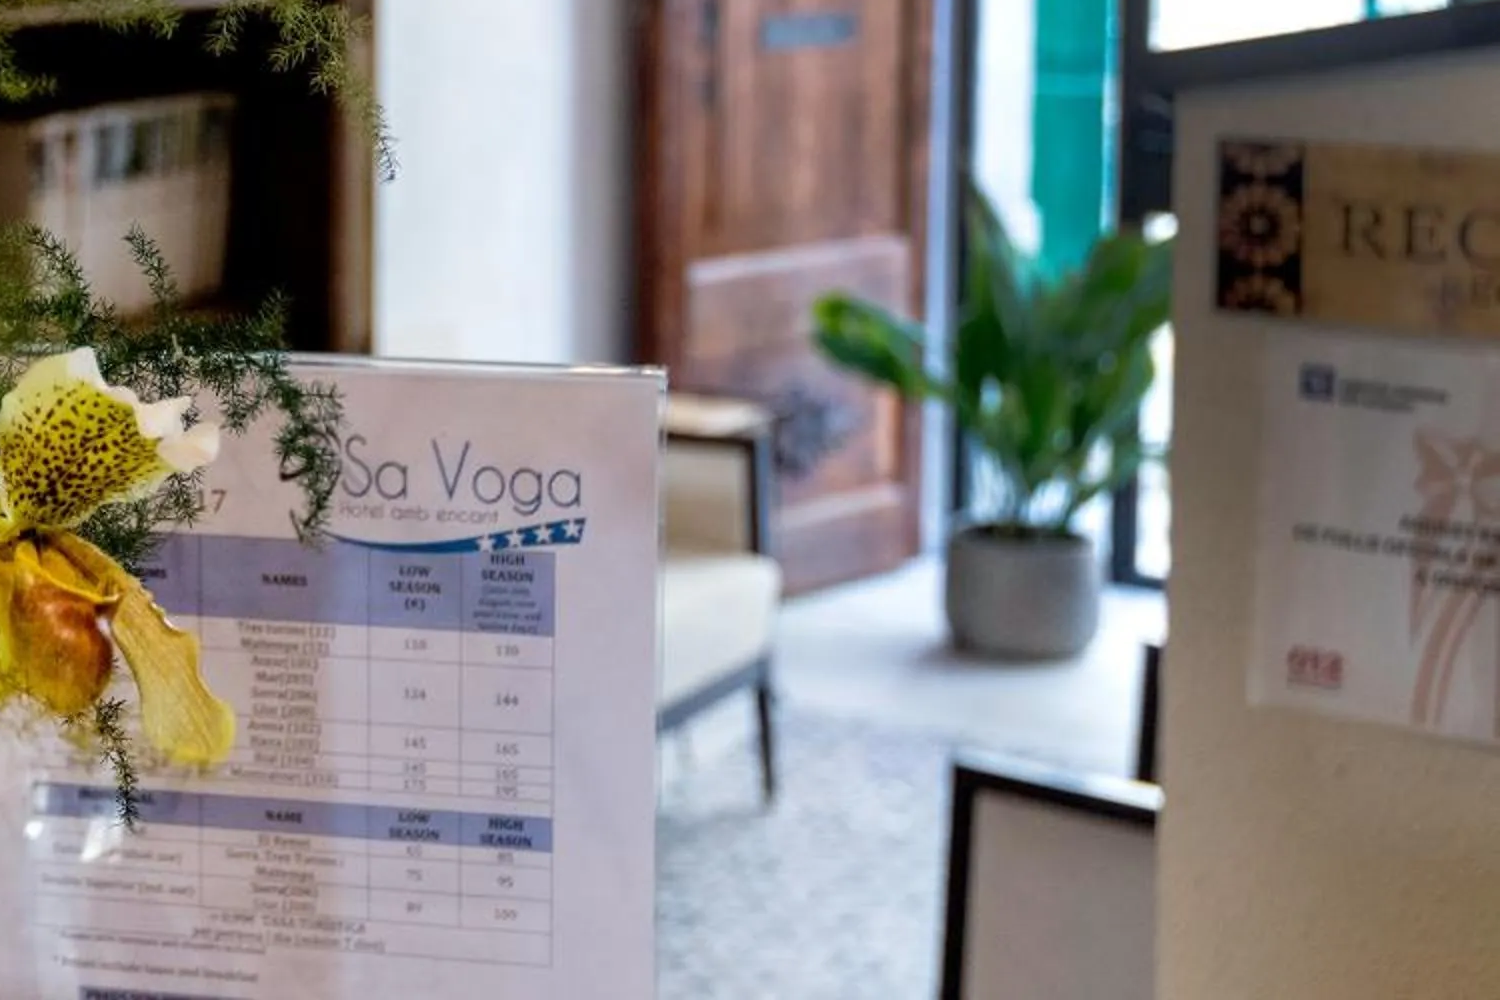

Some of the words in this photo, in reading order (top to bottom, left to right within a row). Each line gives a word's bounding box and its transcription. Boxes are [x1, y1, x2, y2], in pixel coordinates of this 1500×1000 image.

[341, 433, 409, 501] Sa
[431, 438, 582, 516] Voga
[339, 501, 384, 520] Hotel
[389, 502, 429, 522] amb
[435, 506, 499, 524] encant
[490, 552, 526, 566] HIGH
[398, 565, 432, 578] LOW
[480, 569, 535, 584] SEASON
[261, 572, 308, 588] NAMES
[388, 581, 442, 595] SEASON
[495, 693, 519, 706] 144
[265, 809, 303, 823] NAME
[398, 811, 431, 825] LOW
[488, 818, 524, 832] HIGH
[388, 827, 440, 841] SEASON
[479, 832, 533, 848] SEASON
